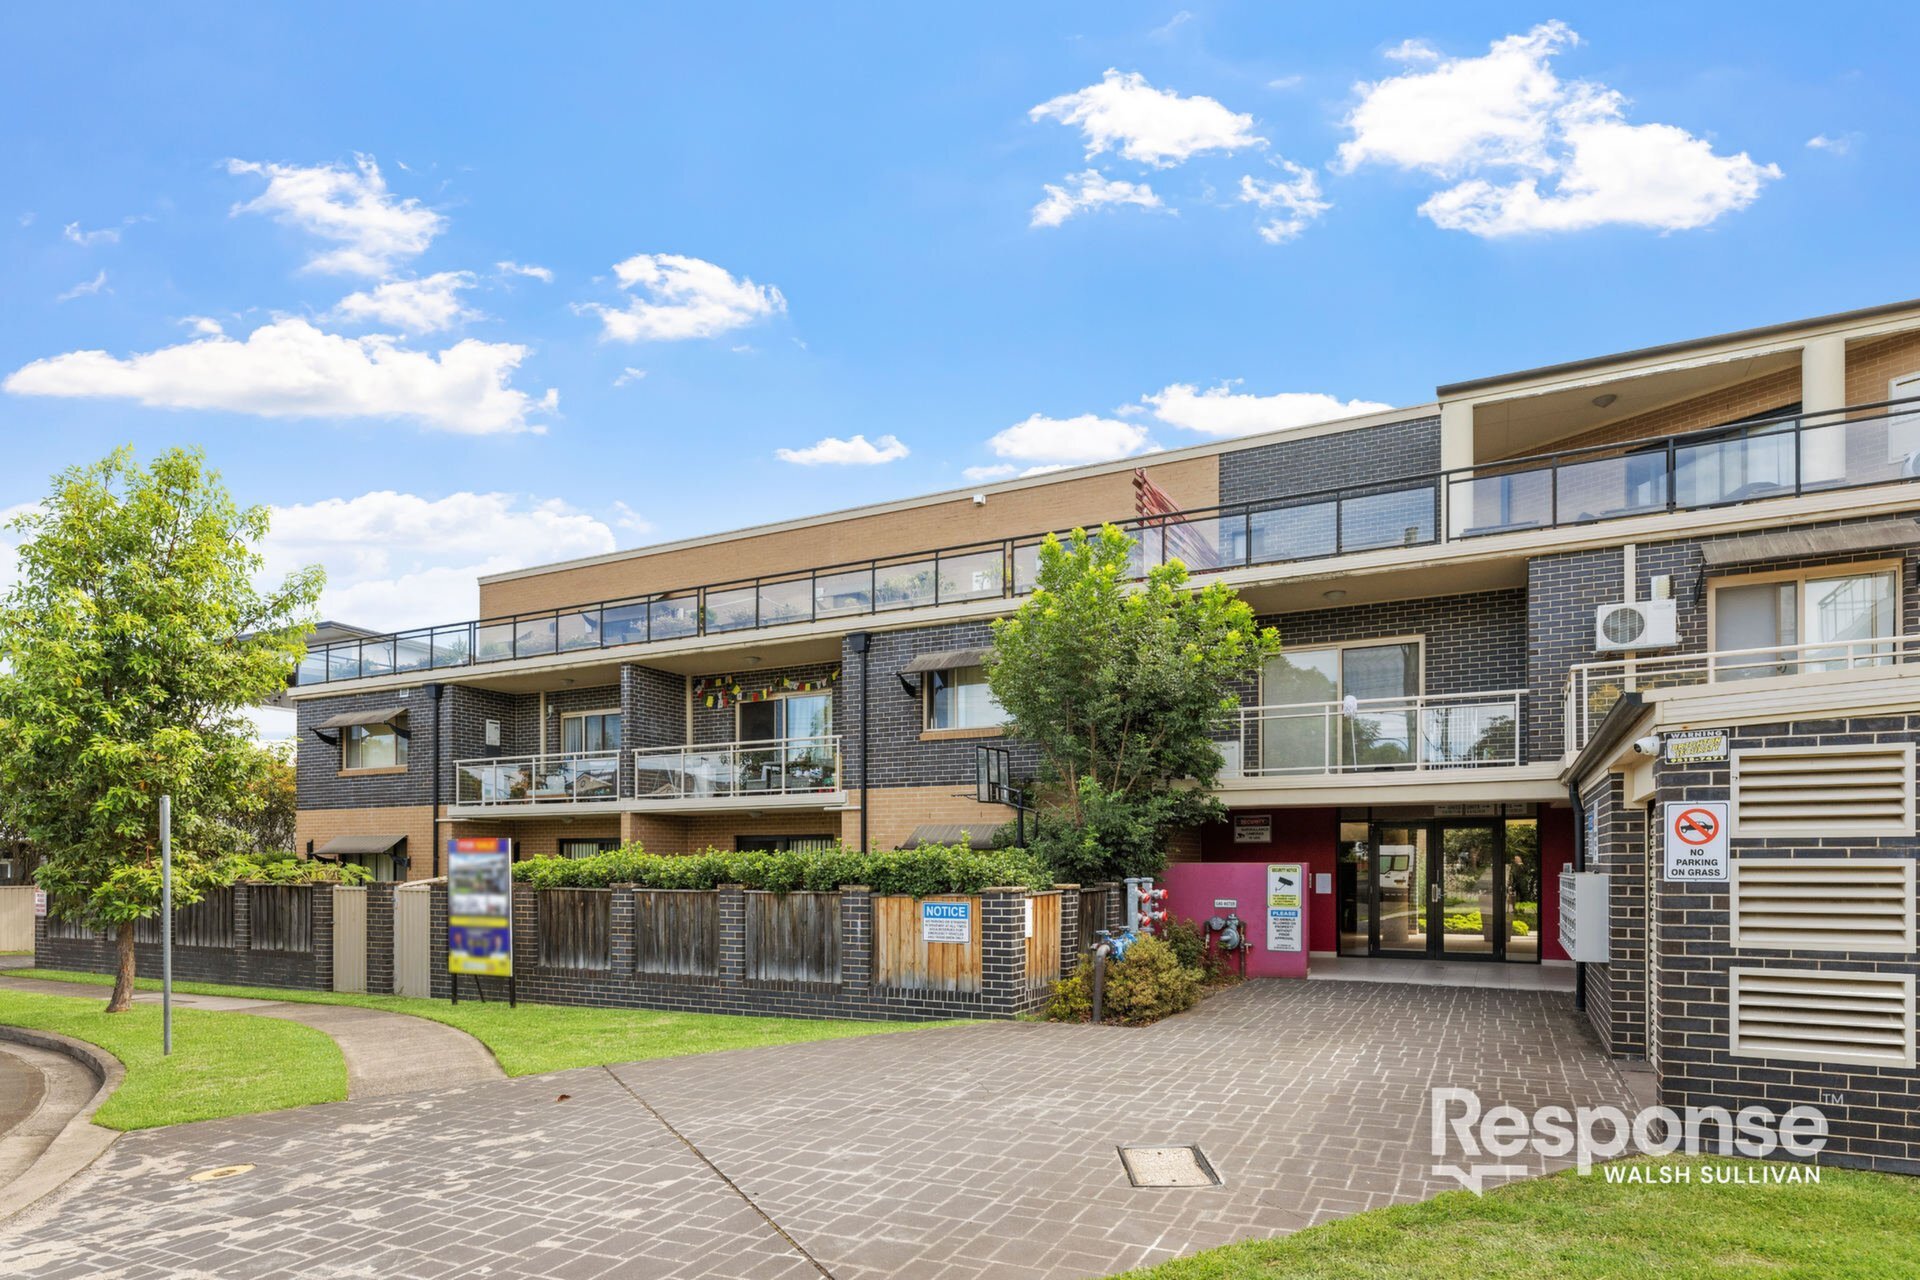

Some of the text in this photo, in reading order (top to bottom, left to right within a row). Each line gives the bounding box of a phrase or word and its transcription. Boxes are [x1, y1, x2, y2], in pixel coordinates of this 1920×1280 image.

[1670, 731, 1723, 739] WARNING
[1671, 737, 1722, 751] BRIGHTON
[1676, 745, 1719, 757] SECURITY
[926, 906, 966, 917] NOTICE
